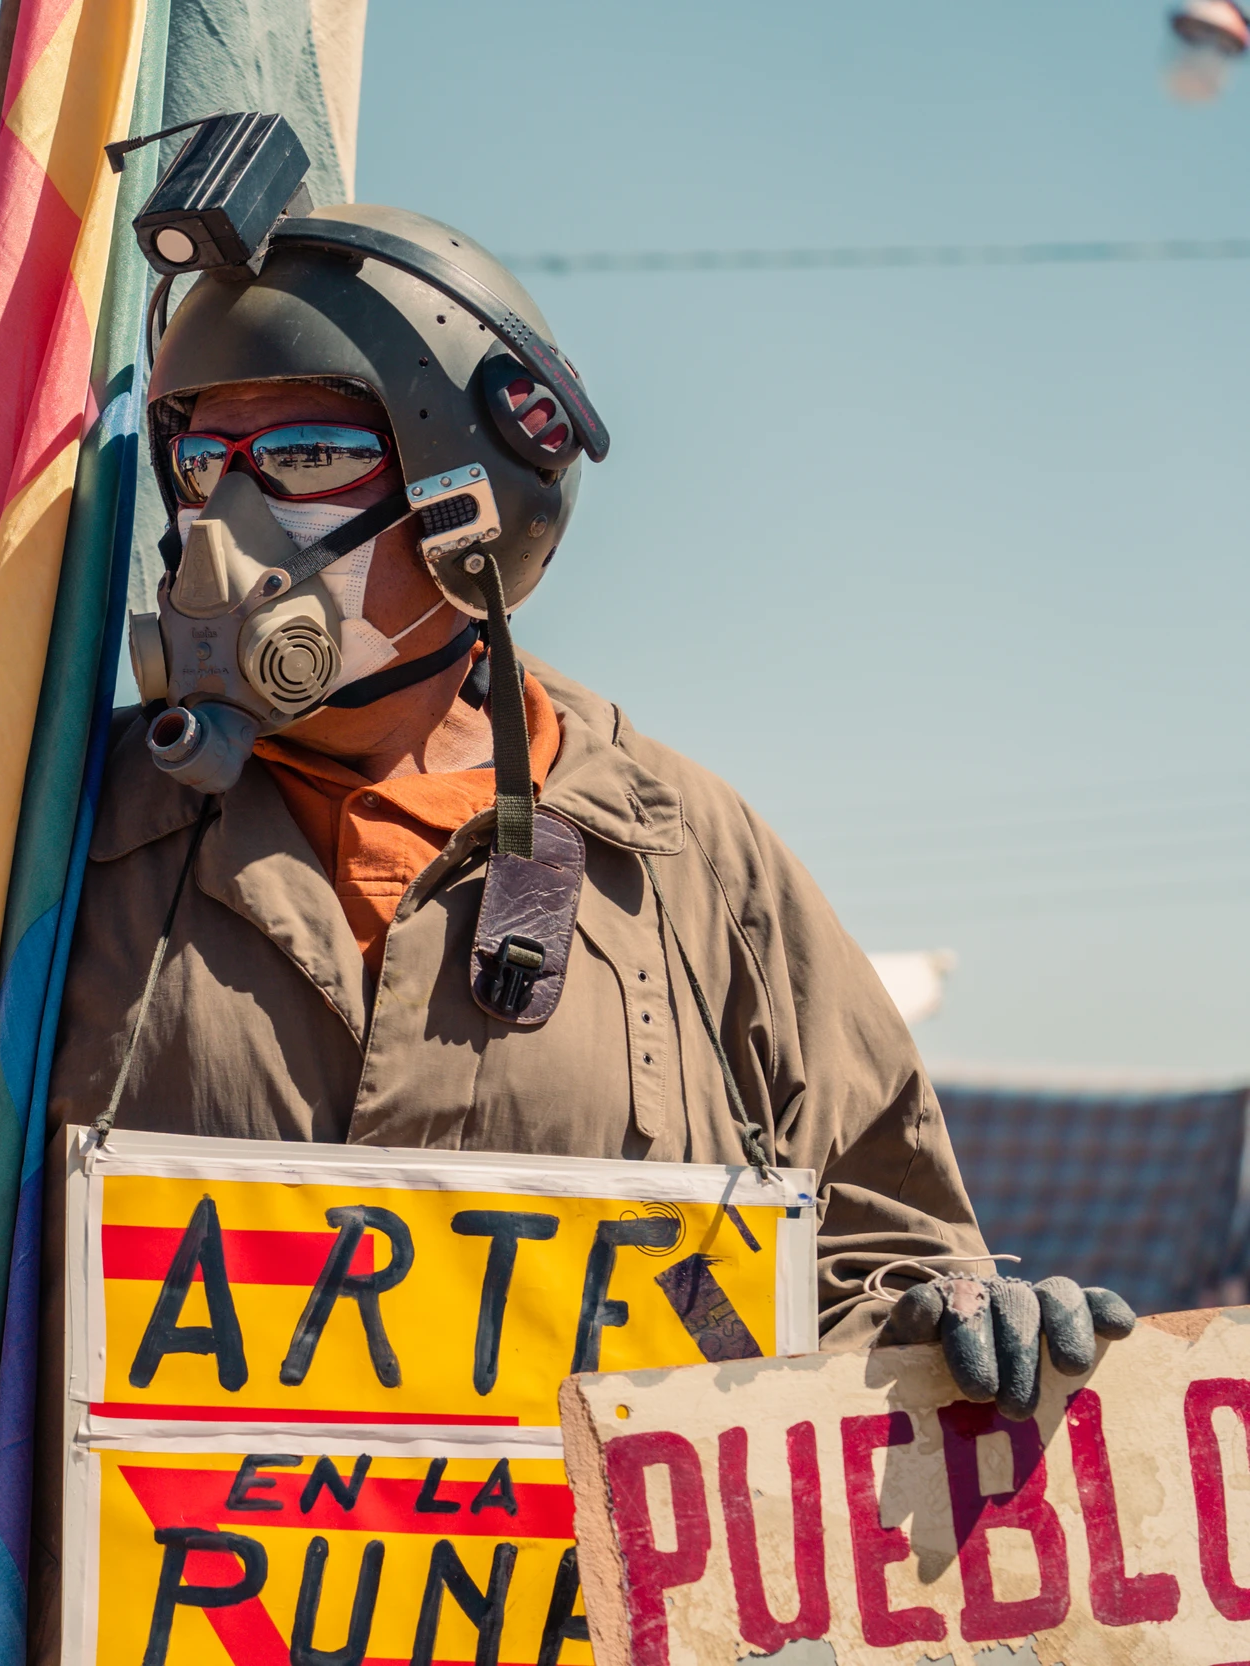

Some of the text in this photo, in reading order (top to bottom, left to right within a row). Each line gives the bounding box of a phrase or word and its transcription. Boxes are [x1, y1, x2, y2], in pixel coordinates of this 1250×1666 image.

[225, 1453, 519, 1517] EN LA
[603, 1377, 1250, 1666] PUEBLO
